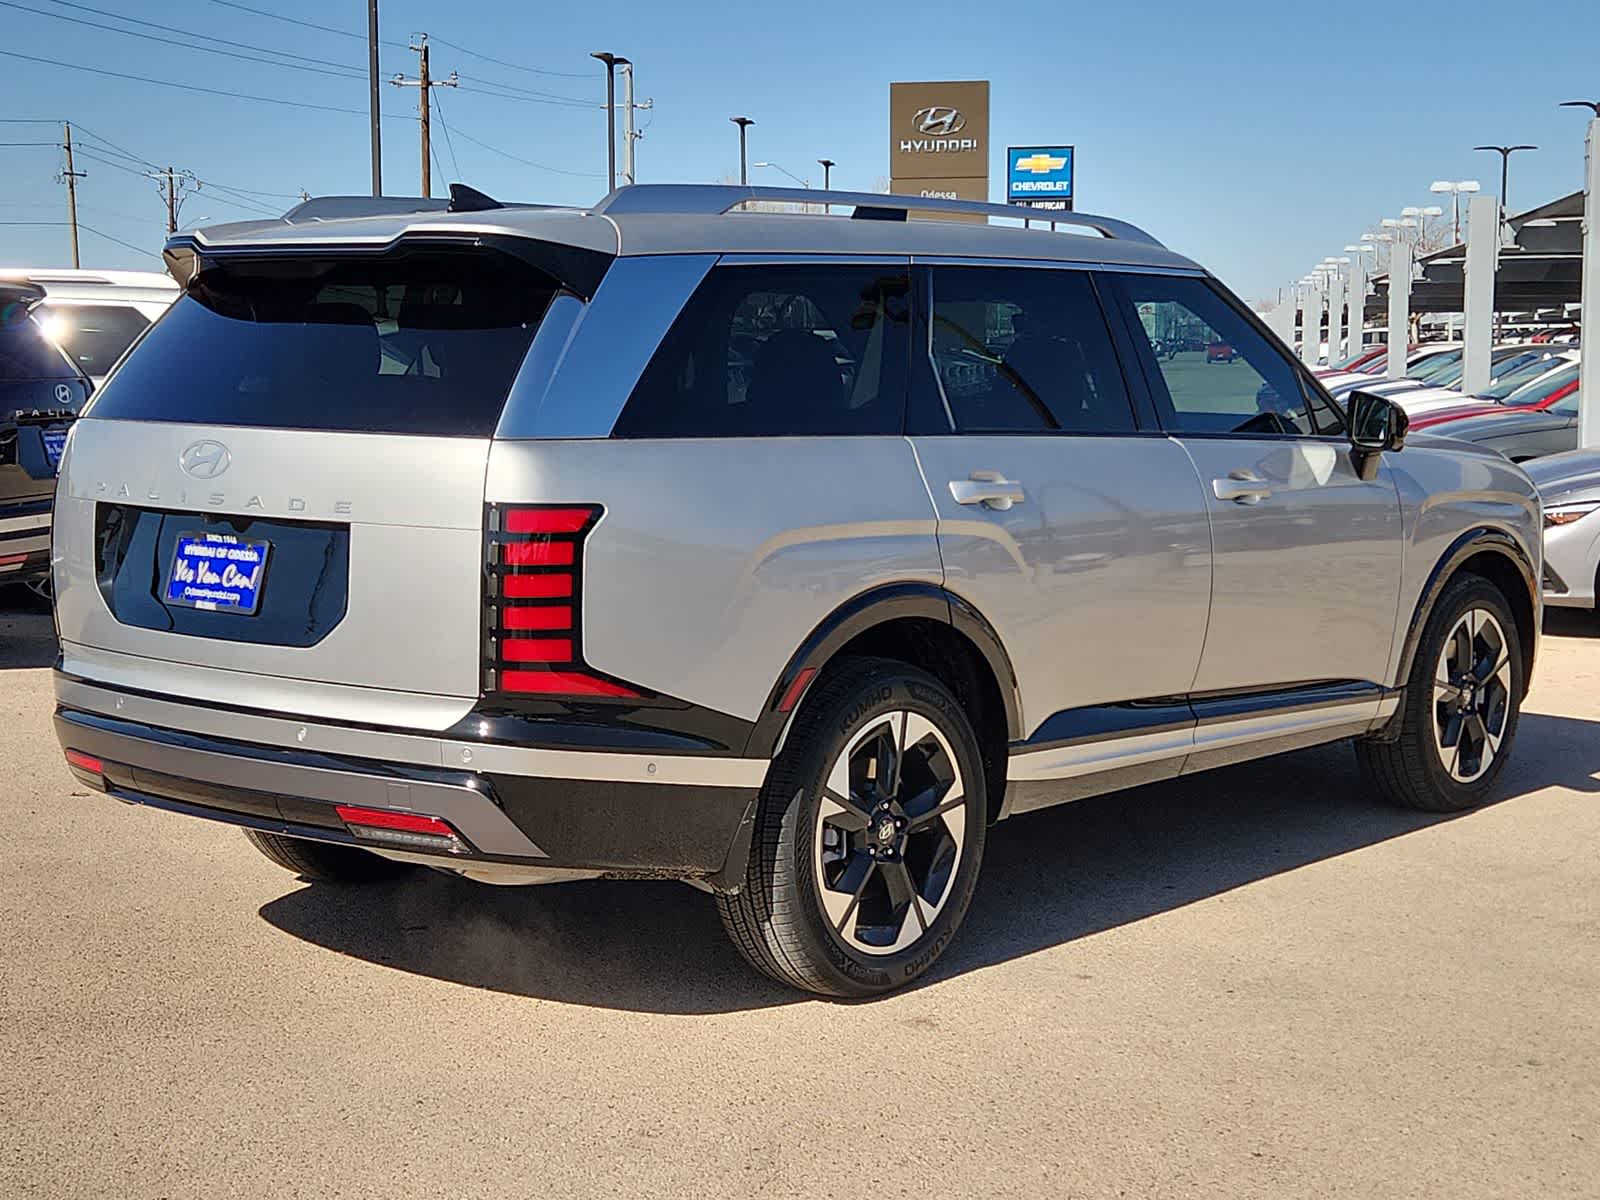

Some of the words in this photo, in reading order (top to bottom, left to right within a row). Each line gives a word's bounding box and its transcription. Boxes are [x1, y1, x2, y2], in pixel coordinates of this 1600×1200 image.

[900, 139, 977, 152] HYUNDAI
[1012, 181, 1069, 192] CHEVROLET
[920, 189, 957, 200] Odessa
[96, 480, 353, 514] PALISADE
[175, 557, 195, 584] Yes
[197, 560, 221, 585] You
[222, 563, 260, 590] Can!
